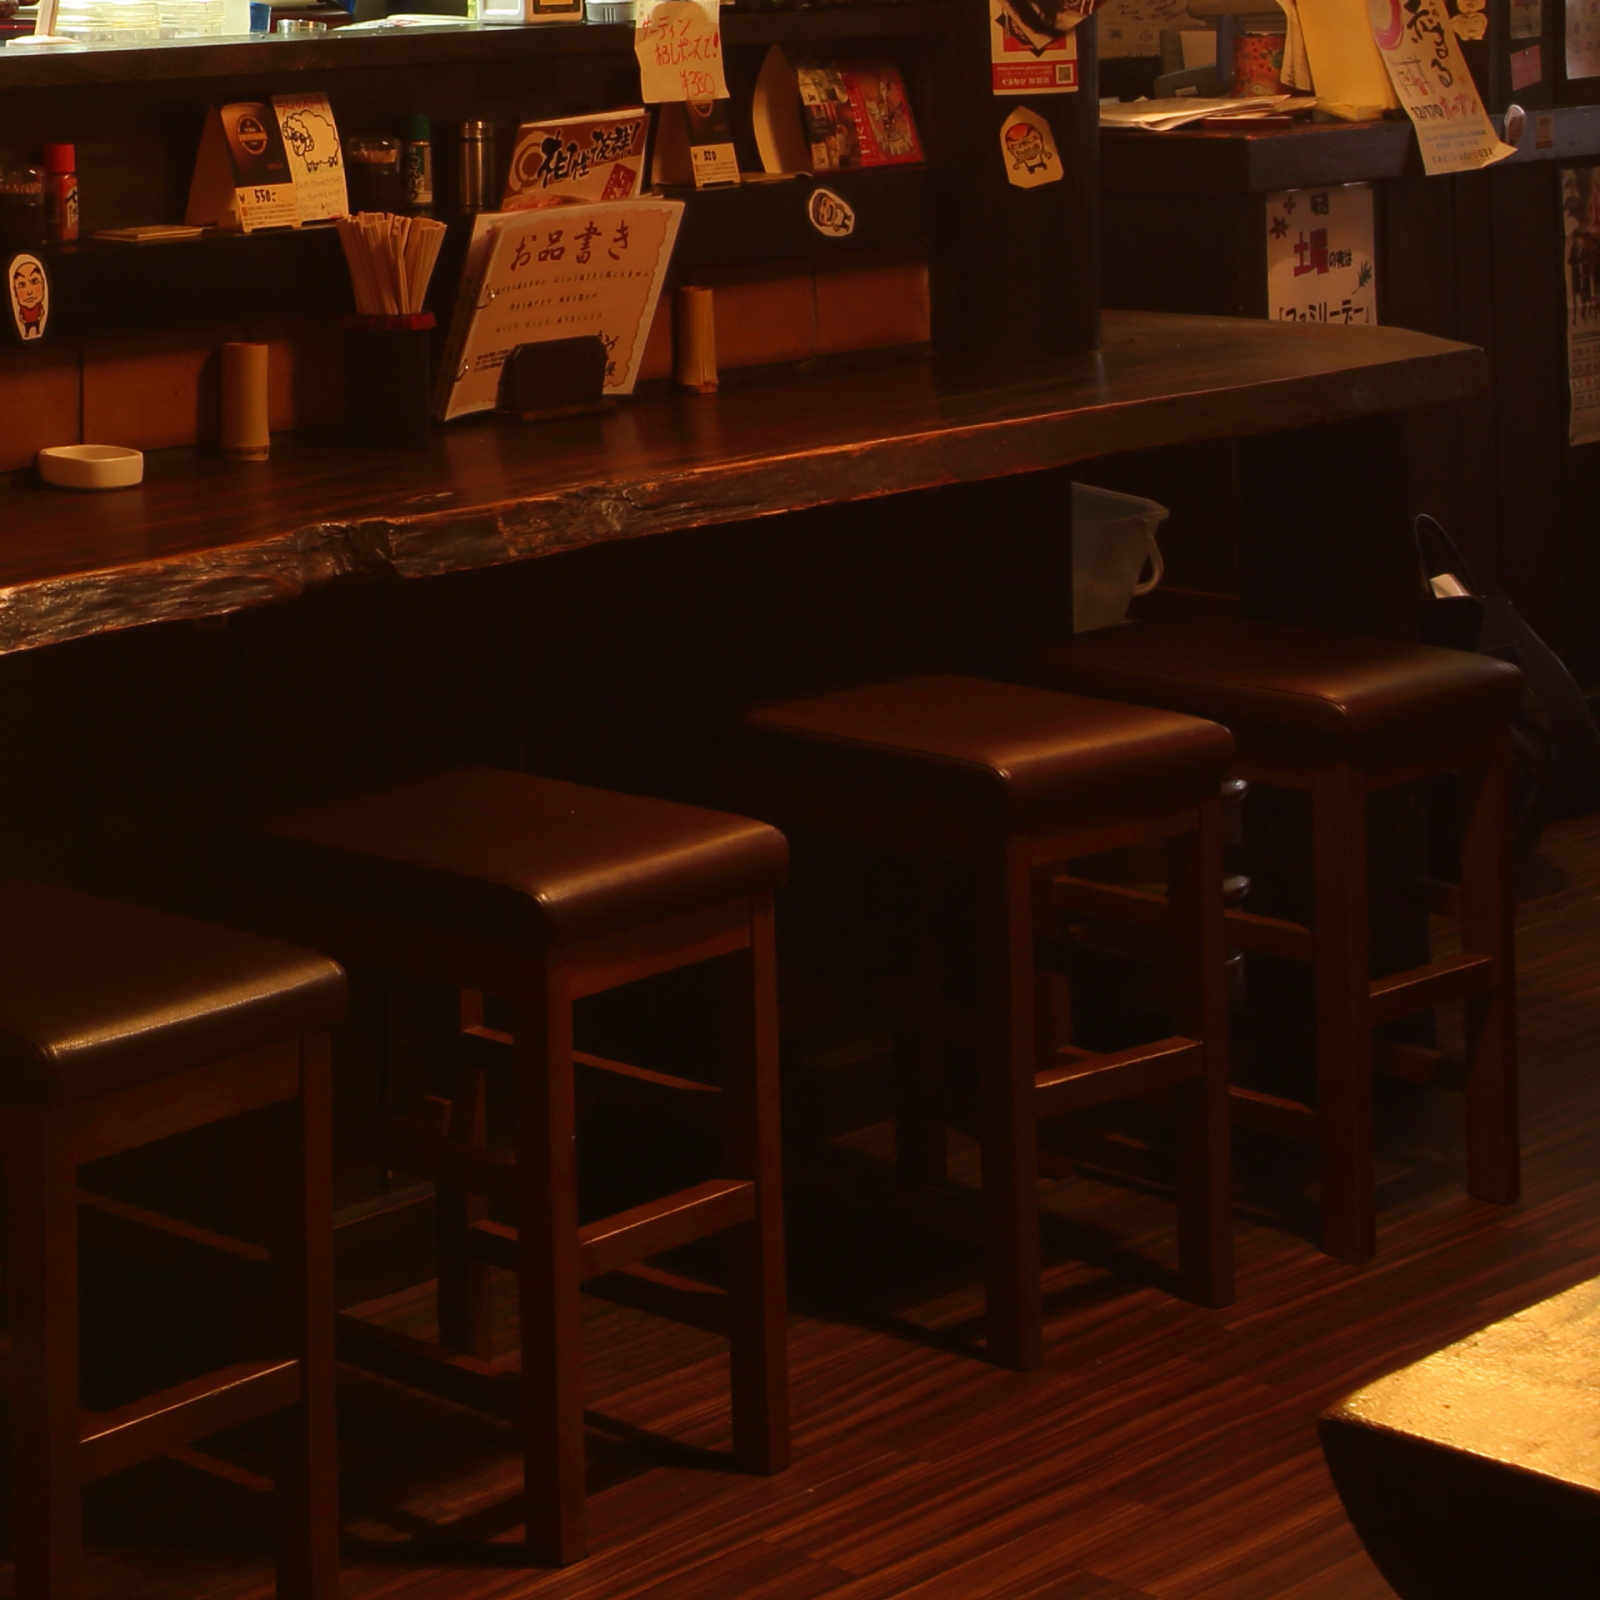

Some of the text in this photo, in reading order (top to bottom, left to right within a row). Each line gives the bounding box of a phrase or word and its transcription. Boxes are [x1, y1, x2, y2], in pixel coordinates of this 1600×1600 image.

[642, 14, 693, 41] サーディン
[510, 220, 631, 273] お品書き
